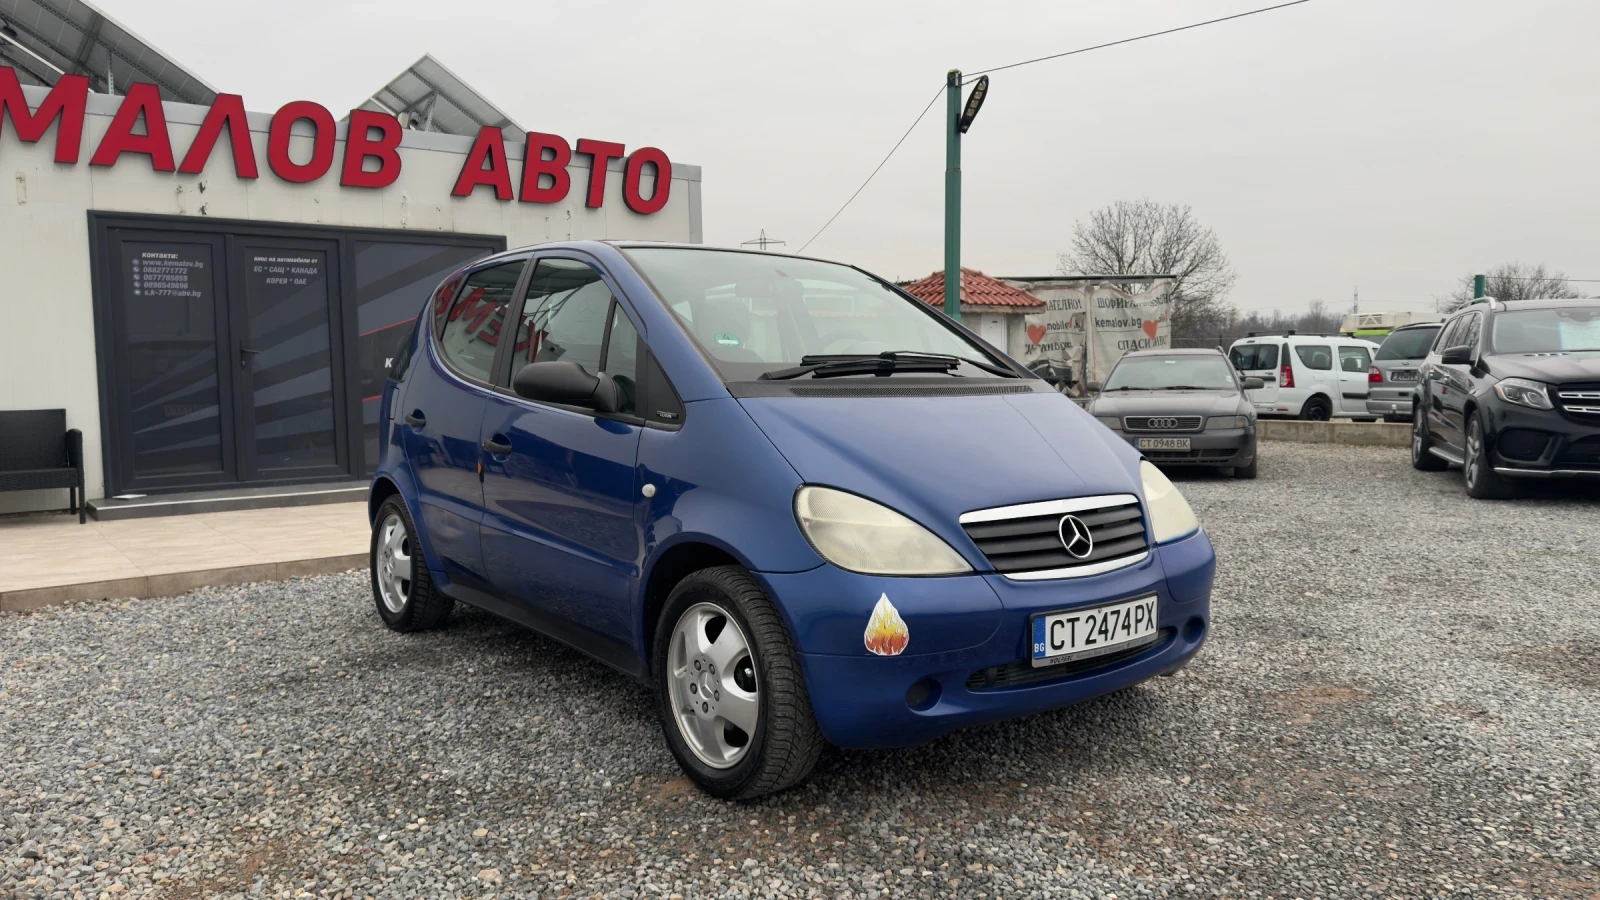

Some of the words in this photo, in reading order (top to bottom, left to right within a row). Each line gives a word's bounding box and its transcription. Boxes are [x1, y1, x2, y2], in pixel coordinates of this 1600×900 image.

[0, 66, 403, 188] МАЛОВ
[450, 125, 672, 215] АВТО
[142, 259, 204, 268] www.kemalov.bg
[269, 266, 285, 274] САЩ
[291, 267, 318, 275] КАНАДА
[144, 289, 202, 298] s.k-777@abv.bg
[1095, 316, 1142, 328] kemalov.bg
[1118, 338, 1150, 350] СПАСИ
[1140, 439, 1152, 448] CT
[1153, 439, 1175, 448] 0948
[1176, 439, 1188, 448] BK
[1034, 643, 1045, 653] BG
[1050, 617, 1080, 651] CT
[1085, 607, 1131, 645] 2474
[1134, 601, 1154, 634] PX
